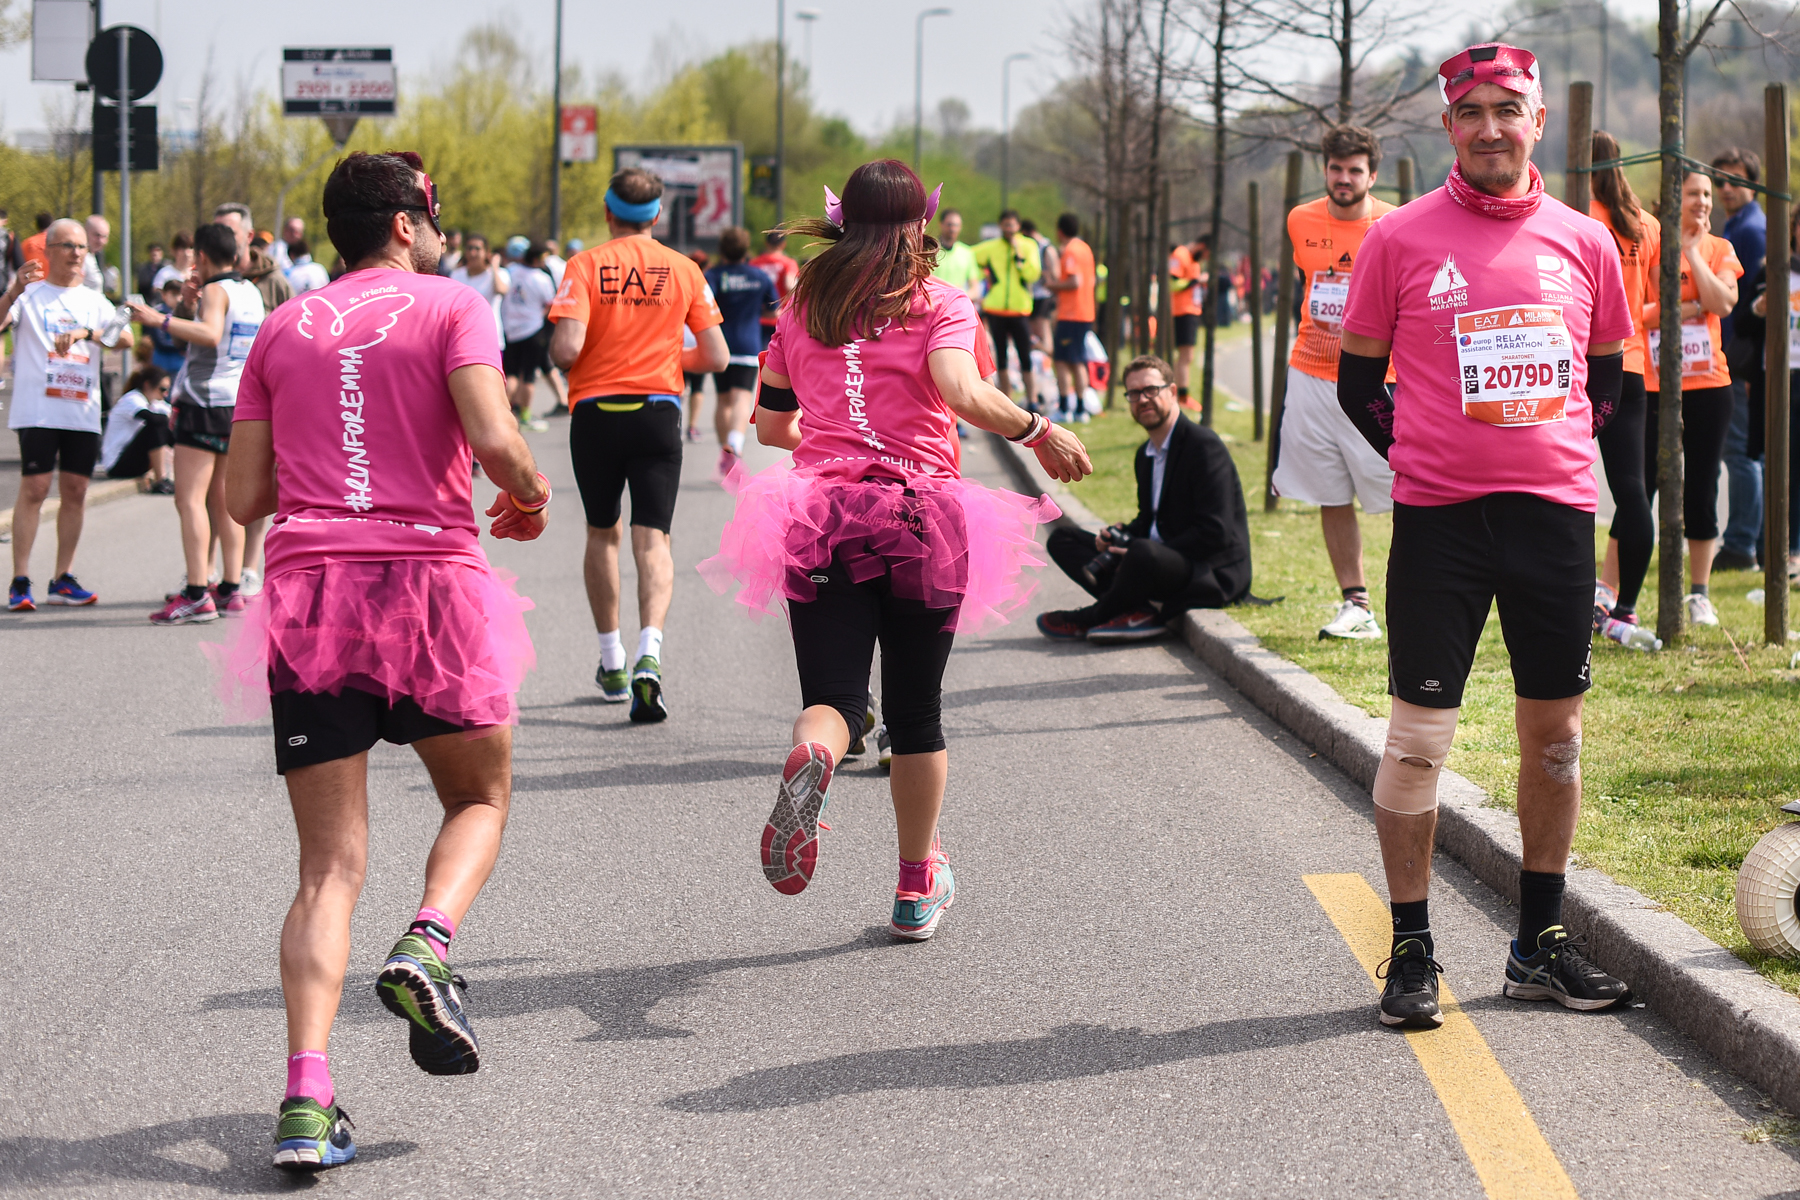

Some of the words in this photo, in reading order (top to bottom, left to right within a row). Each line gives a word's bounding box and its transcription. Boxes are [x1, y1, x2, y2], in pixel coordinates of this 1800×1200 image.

[600, 265, 671, 296] EA7
[361, 285, 398, 298] friends
[1540, 292, 1574, 301] ITALIANA
[1430, 292, 1468, 306] MILANO
[1431, 300, 1469, 311] MARATHON
[1473, 314, 1499, 328] EA7
[1524, 311, 1551, 320] MILANO
[1495, 333, 1527, 343] RELAY
[1460, 345, 1493, 353] assistance
[1496, 341, 1543, 350] MARATHON
[1501, 353, 1535, 361] SMARATONETI
[1483, 363, 1554, 390] 2079D
[1502, 400, 1540, 418] EA7
[338, 347, 374, 512] #RUNFOREMMA
